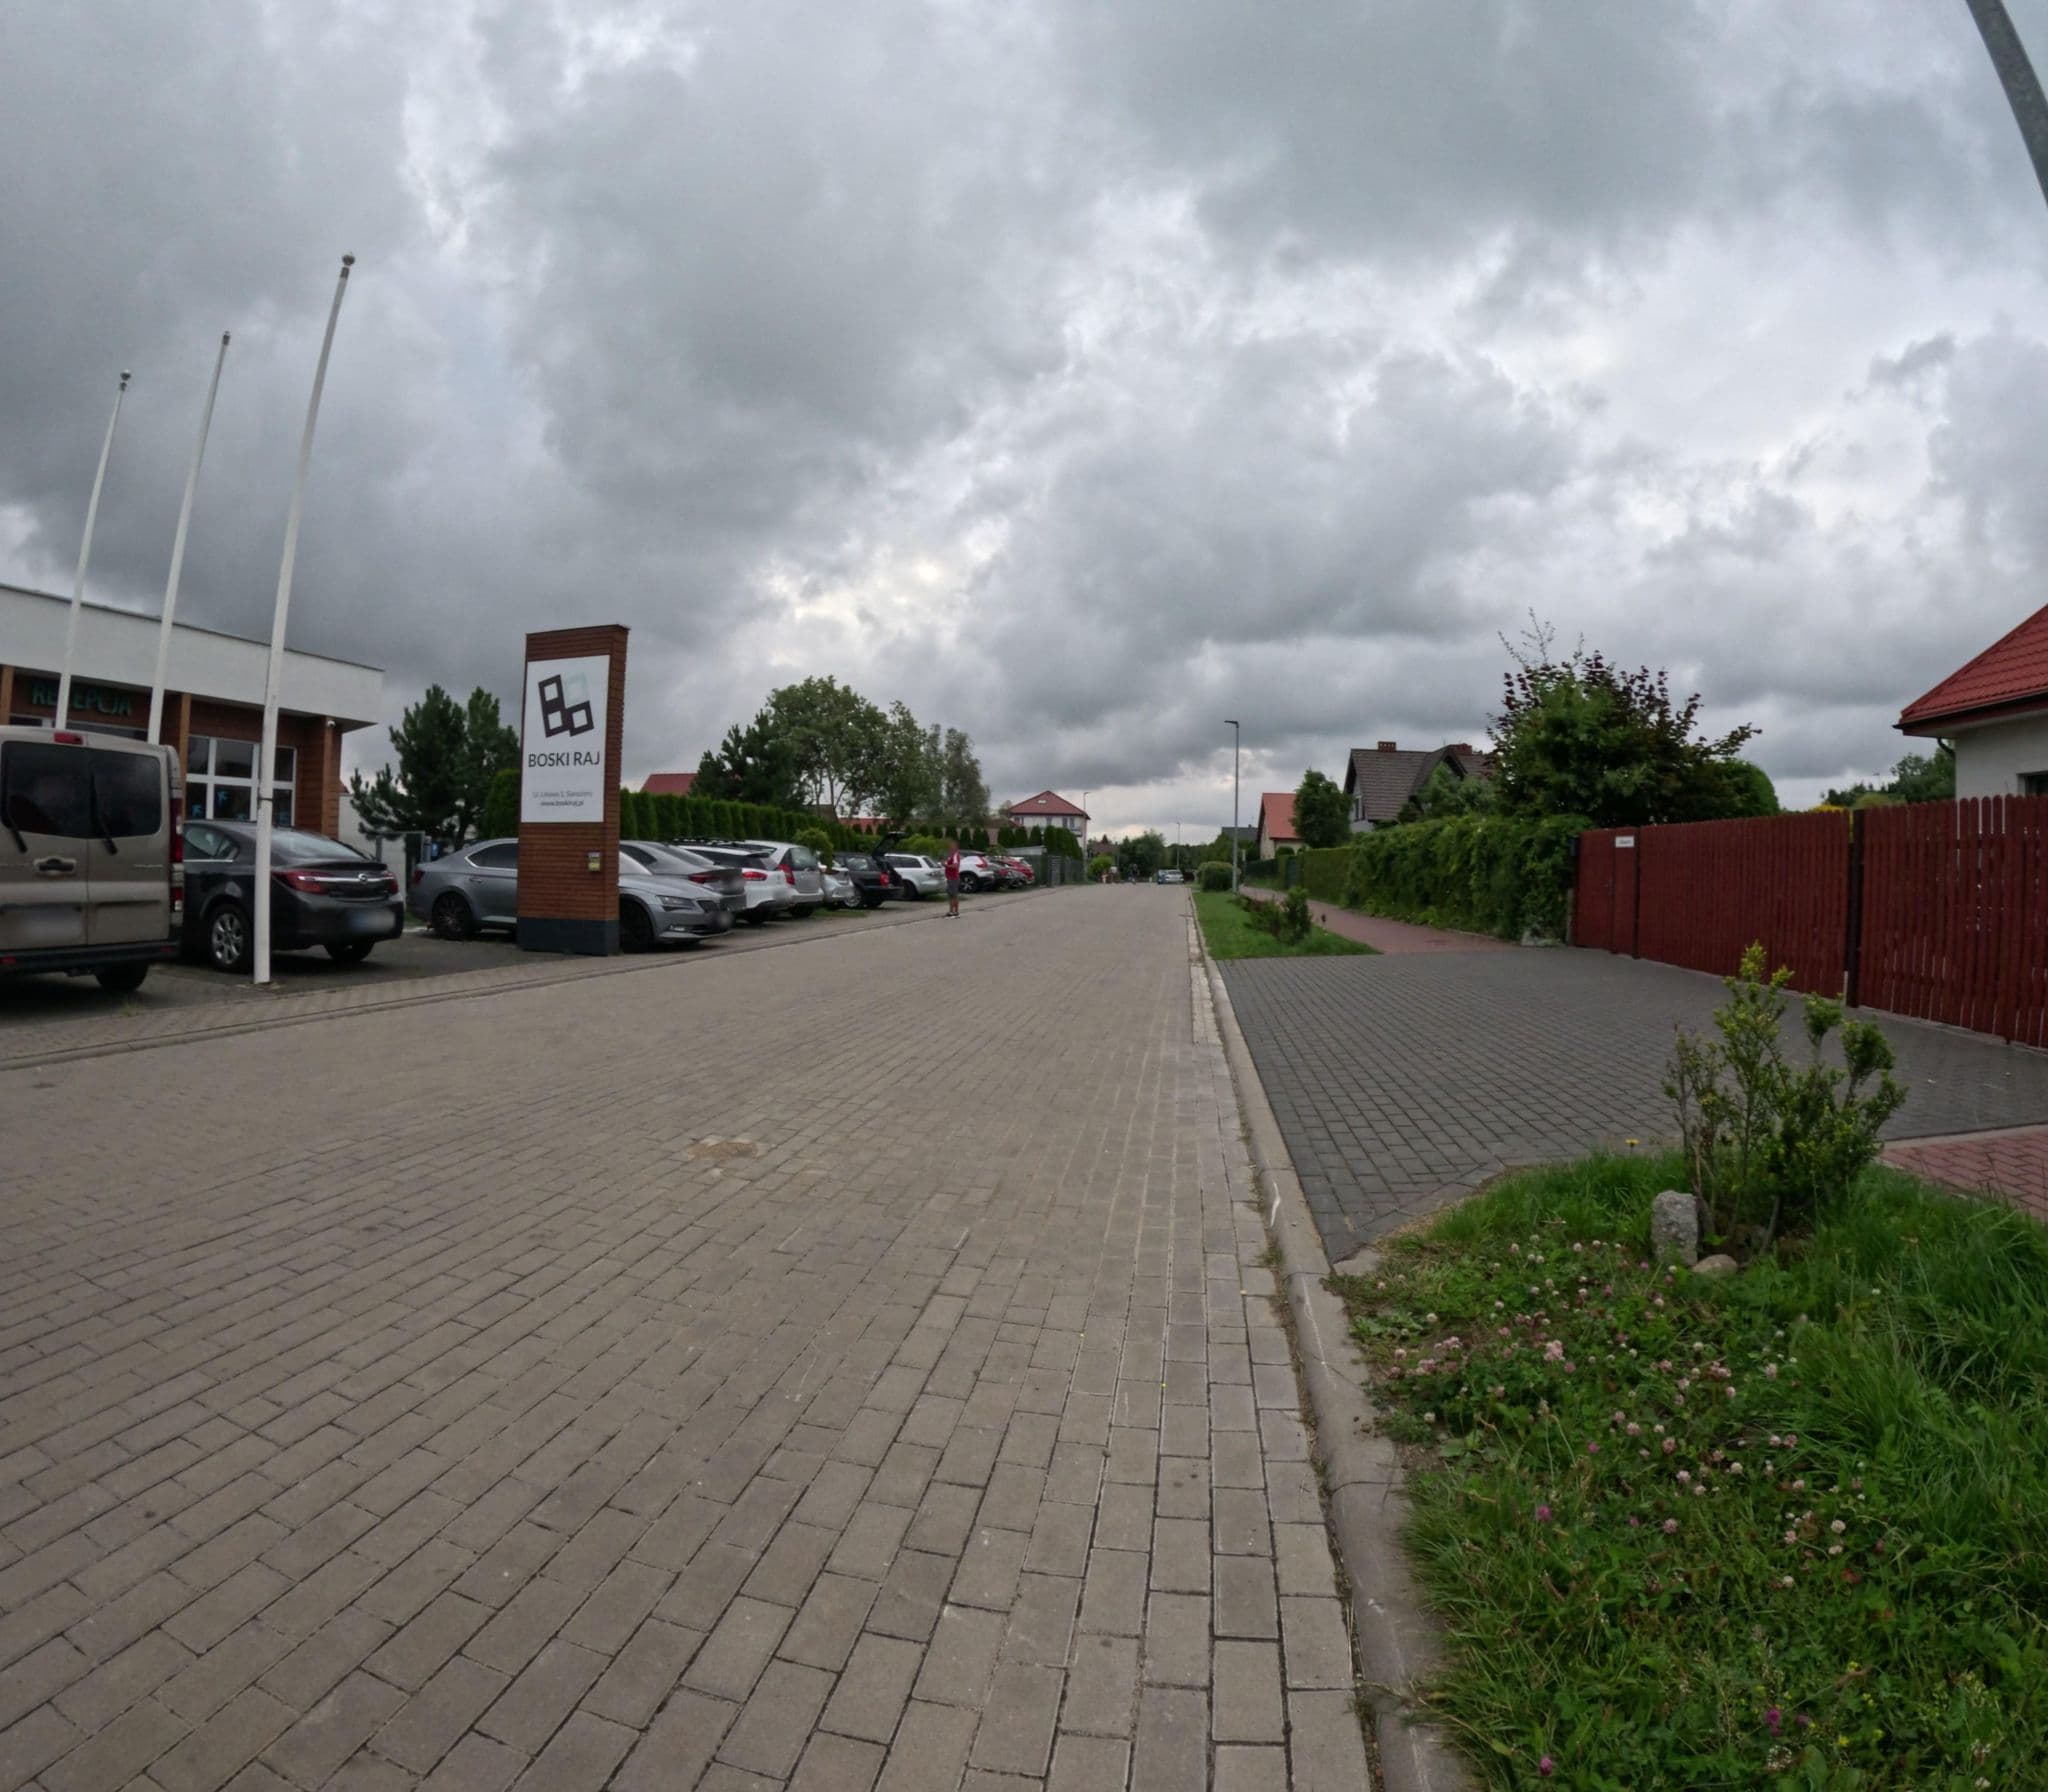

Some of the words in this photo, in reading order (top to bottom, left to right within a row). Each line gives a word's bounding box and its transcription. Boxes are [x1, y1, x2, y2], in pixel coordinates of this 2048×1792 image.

[32, 678, 132, 716] REEPCJA
[528, 752, 570, 767] BOSKI
[573, 751, 600, 766] RAJ
